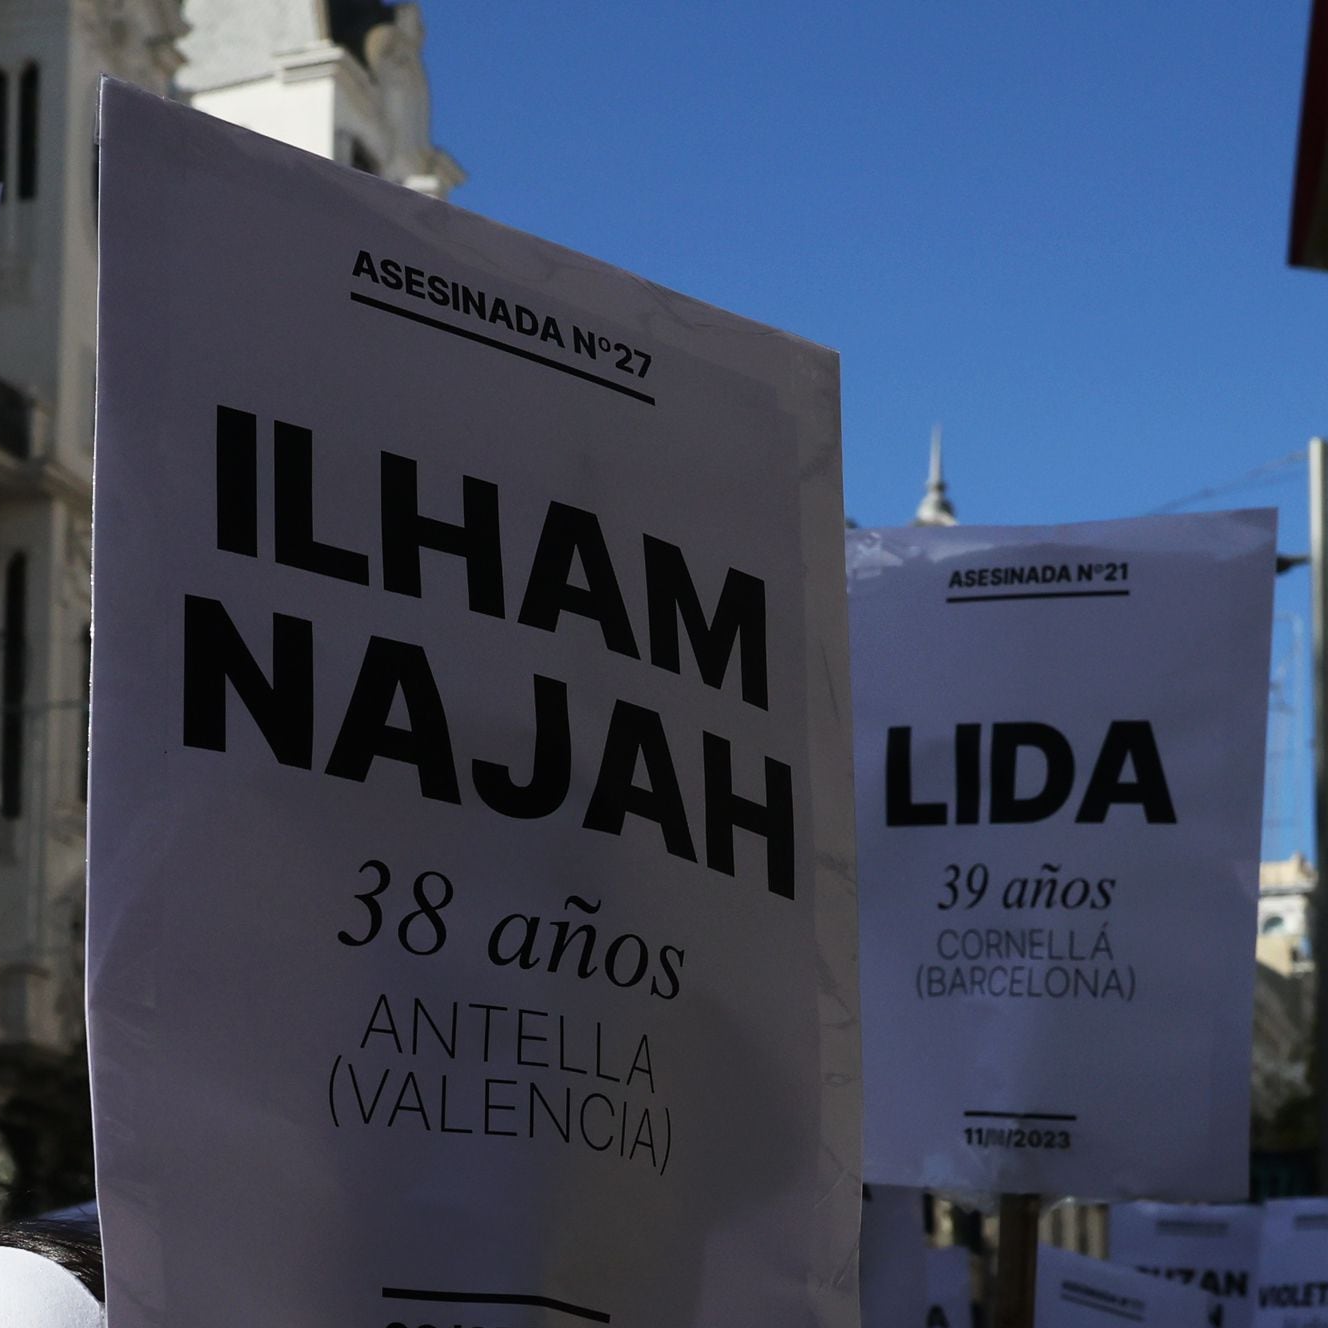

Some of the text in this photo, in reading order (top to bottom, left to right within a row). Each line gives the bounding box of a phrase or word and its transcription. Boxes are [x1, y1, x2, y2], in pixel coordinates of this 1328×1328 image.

[352, 249, 653, 379] ASESINADA Nº27
[217, 404, 768, 712] ILHAM
[949, 562, 1129, 589] ASESINADA Nº21
[184, 594, 795, 900] NAJAH
[886, 720, 1177, 827] LIDA
[337, 860, 685, 1000] 38 años
[938, 864, 1116, 912] 39 años
[916, 964, 1135, 1002] (BARCELONA)
[937, 922, 1114, 962] CORNELLÁ
[360, 993, 656, 1094] ANTELLA
[329, 1054, 671, 1176] (VALENCIA)
